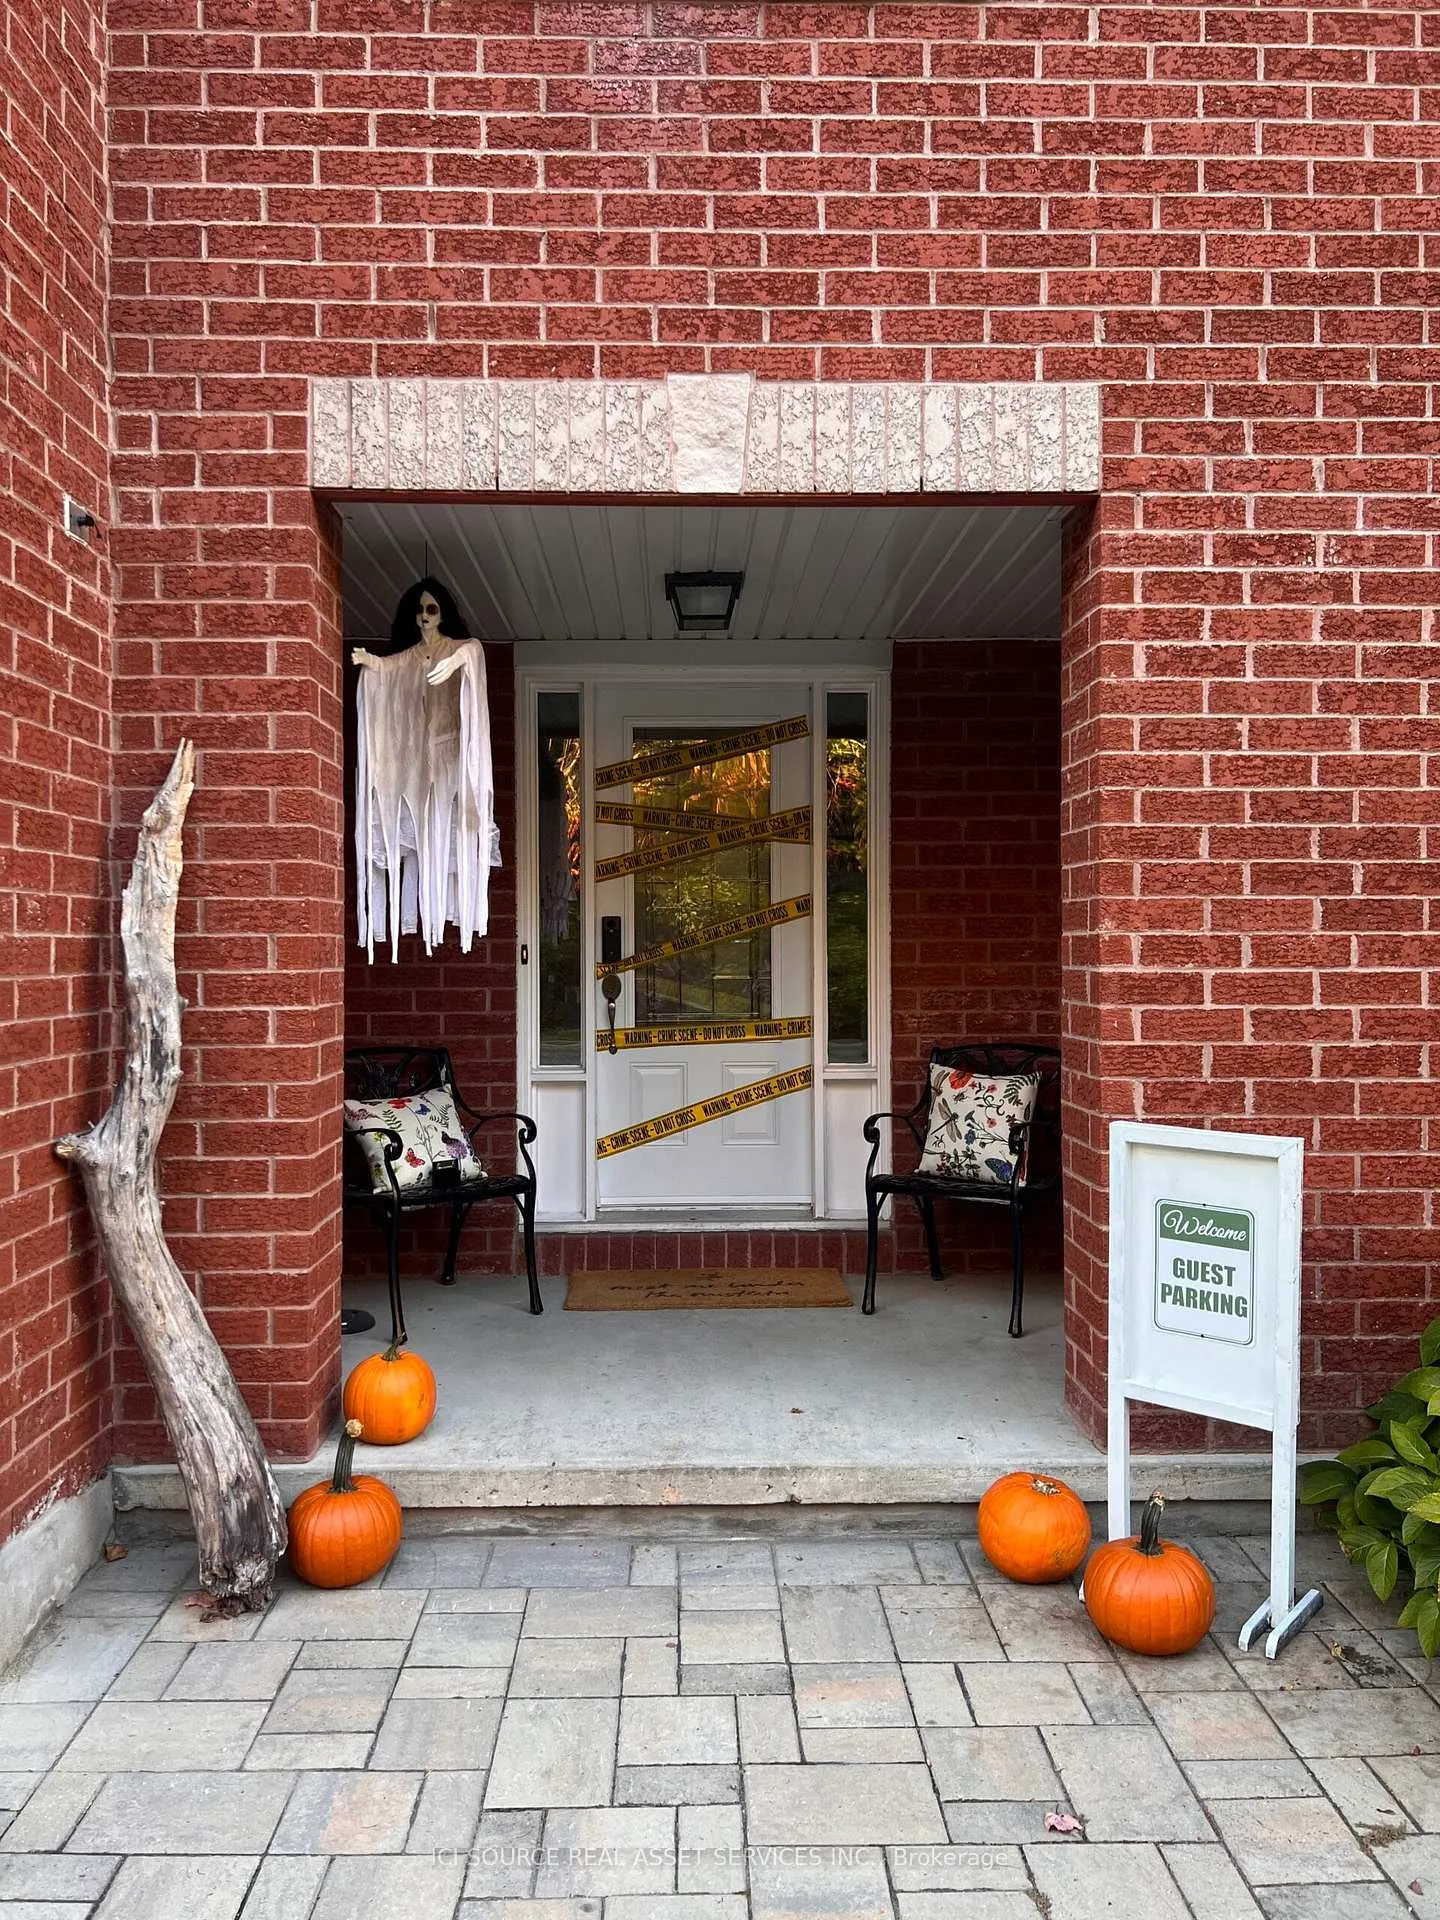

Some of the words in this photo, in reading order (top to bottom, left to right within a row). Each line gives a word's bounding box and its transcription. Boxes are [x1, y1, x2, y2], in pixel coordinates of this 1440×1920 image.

[624, 1030, 652, 1044] WARNING
[658, 1028, 677, 1042] CRIME
[678, 1027, 698, 1041] SCENE
[703, 1027, 711, 1040] DO
[713, 1026, 724, 1040] NOT
[725, 1025, 746, 1039] CROSS
[702, 1096, 731, 1117] WARNING
[733, 1088, 754, 1107] CRIME
[753, 1082, 775, 1099] SCENE
[777, 1077, 787, 1092] DO
[786, 1073, 799, 1089] NOT
[630, 1125, 651, 1143] SCENE
[653, 1121, 664, 1135] DO
[664, 1116, 676, 1132] NOT
[675, 1109, 696, 1127] CROSS
[1163, 1209, 1247, 1241] Welcome
[1172, 1257, 1236, 1287] GUEST
[1160, 1283, 1248, 1318] PARKING
